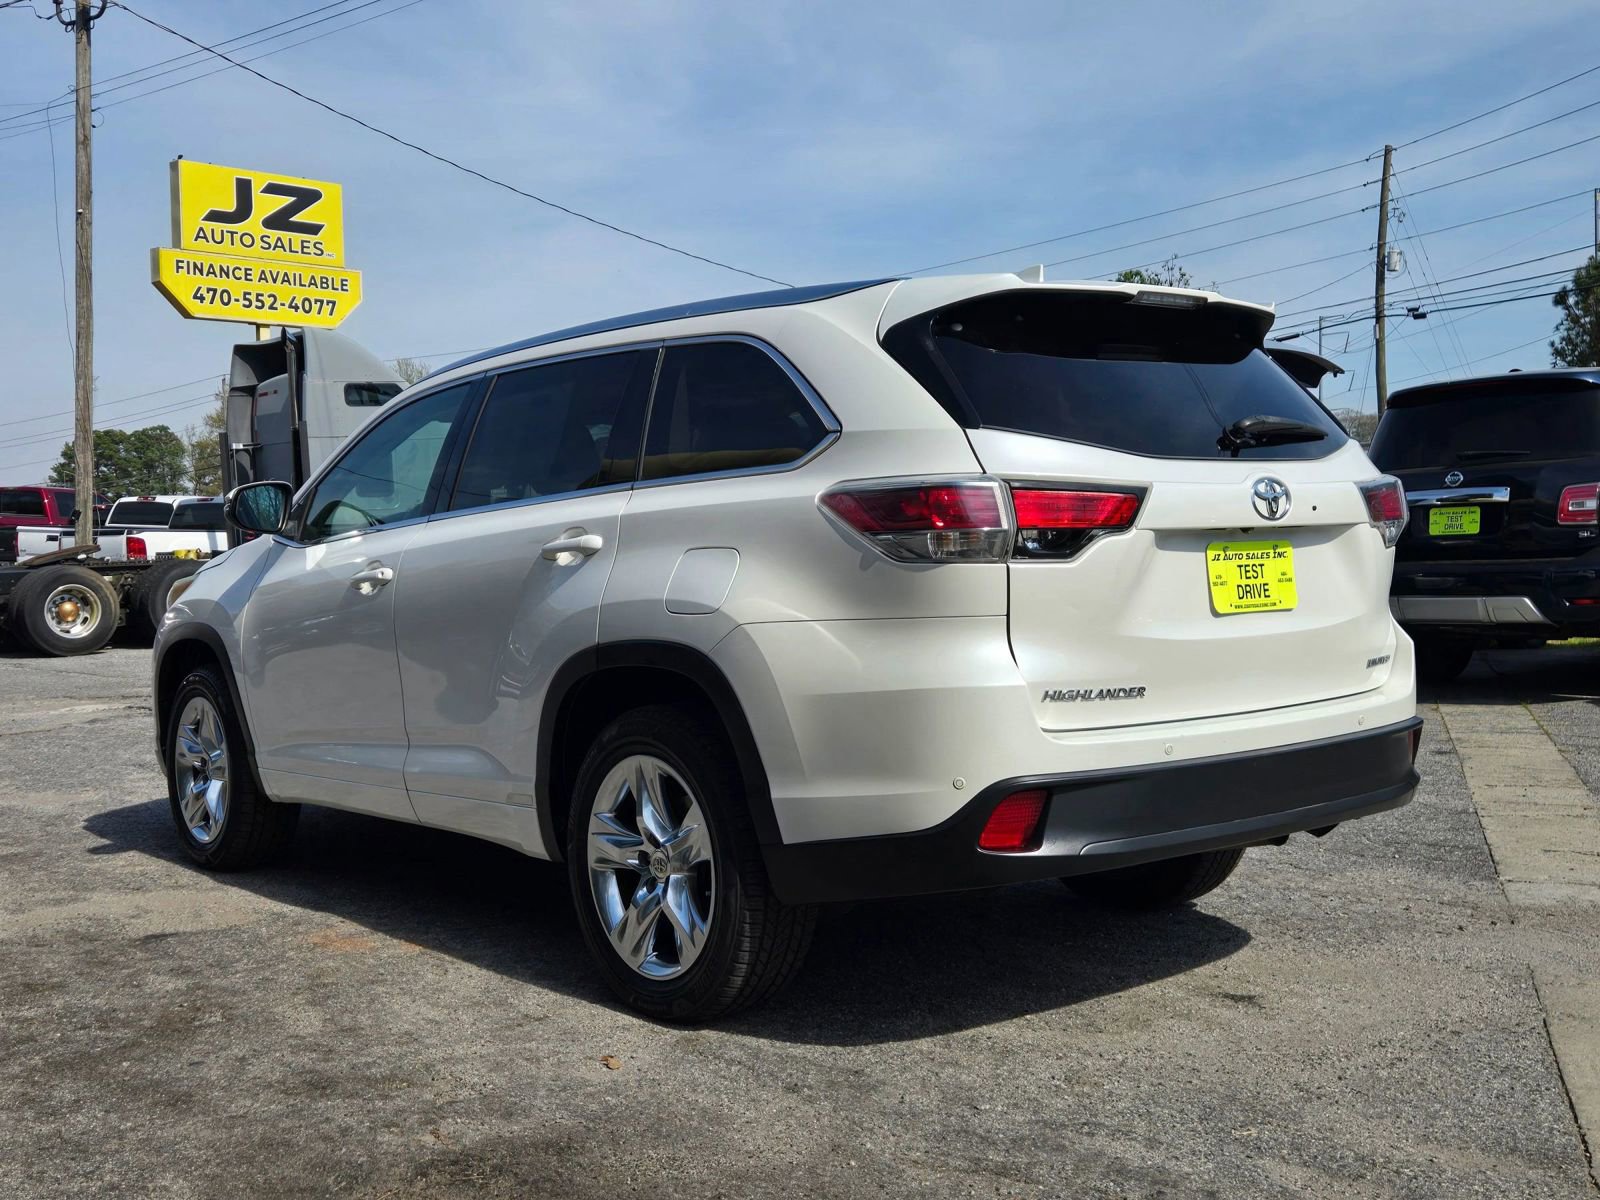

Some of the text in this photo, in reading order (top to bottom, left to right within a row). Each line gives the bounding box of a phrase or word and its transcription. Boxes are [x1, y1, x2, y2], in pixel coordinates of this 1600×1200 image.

[201, 177, 325, 236] JZ
[194, 227, 255, 248] AUTO
[260, 234, 324, 256] SALES
[175, 259, 349, 292] FINANCE AVAILABLE
[192, 286, 336, 316] 470-552-4077
[1447, 515, 1463, 523] TEST
[1212, 553, 1221, 561] JZ
[1223, 552, 1243, 560] AUTO
[1246, 552, 1270, 560] SALES
[1237, 563, 1265, 580] TEST
[1236, 583, 1271, 600] DRIVE
[1040, 686, 1146, 703] HIGHLANDER
